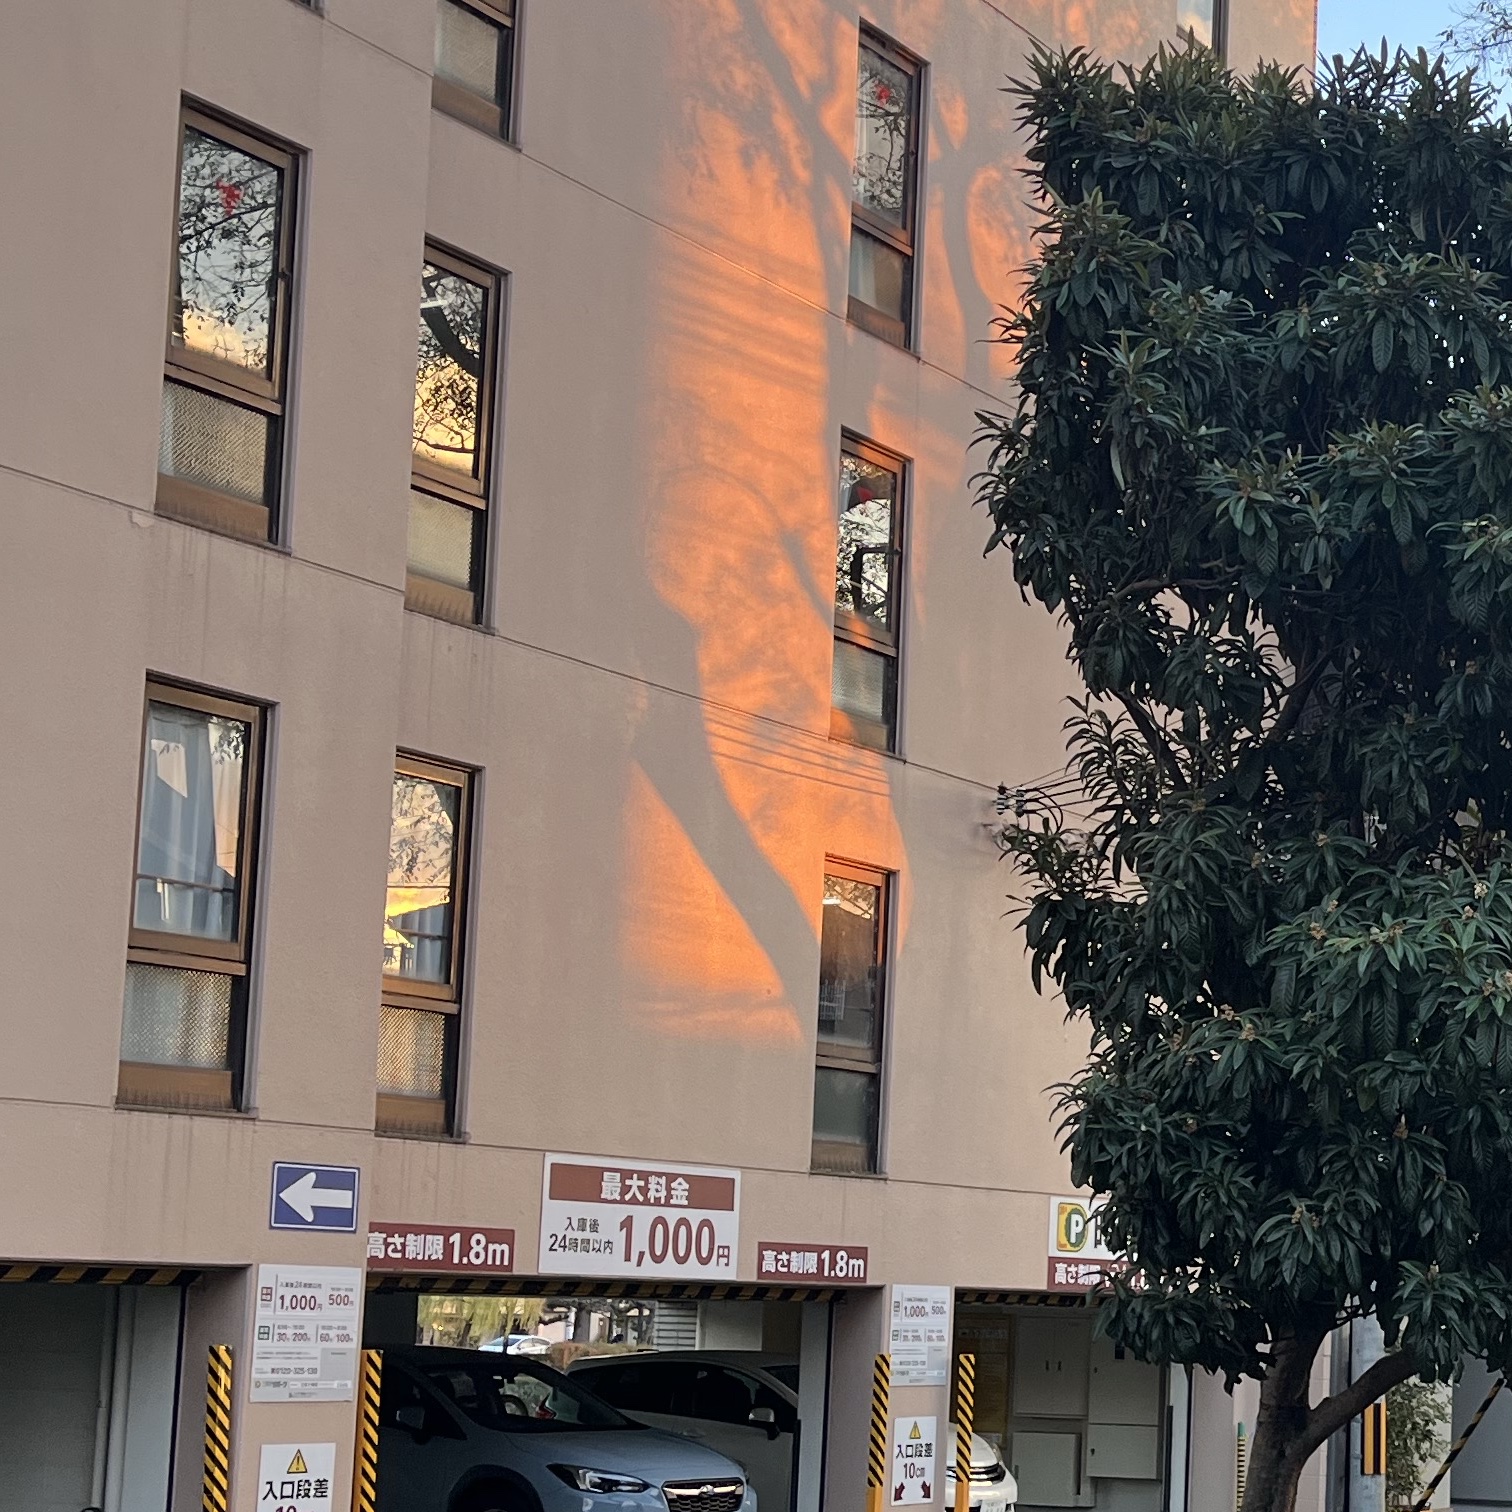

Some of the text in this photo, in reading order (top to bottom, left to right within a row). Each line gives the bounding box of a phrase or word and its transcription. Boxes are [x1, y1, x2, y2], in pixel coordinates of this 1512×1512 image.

[601, 1171, 690, 1206] 最大料金
[564, 1217, 600, 1234] 入庫後
[549, 1234, 614, 1255] 24時間以内
[619, 1215, 731, 1268] 1,000円
[896, 1442, 933, 1459] 入口段差
[903, 1462, 926, 1479] 10cm
[262, 1478, 329, 1501] 入口段差
